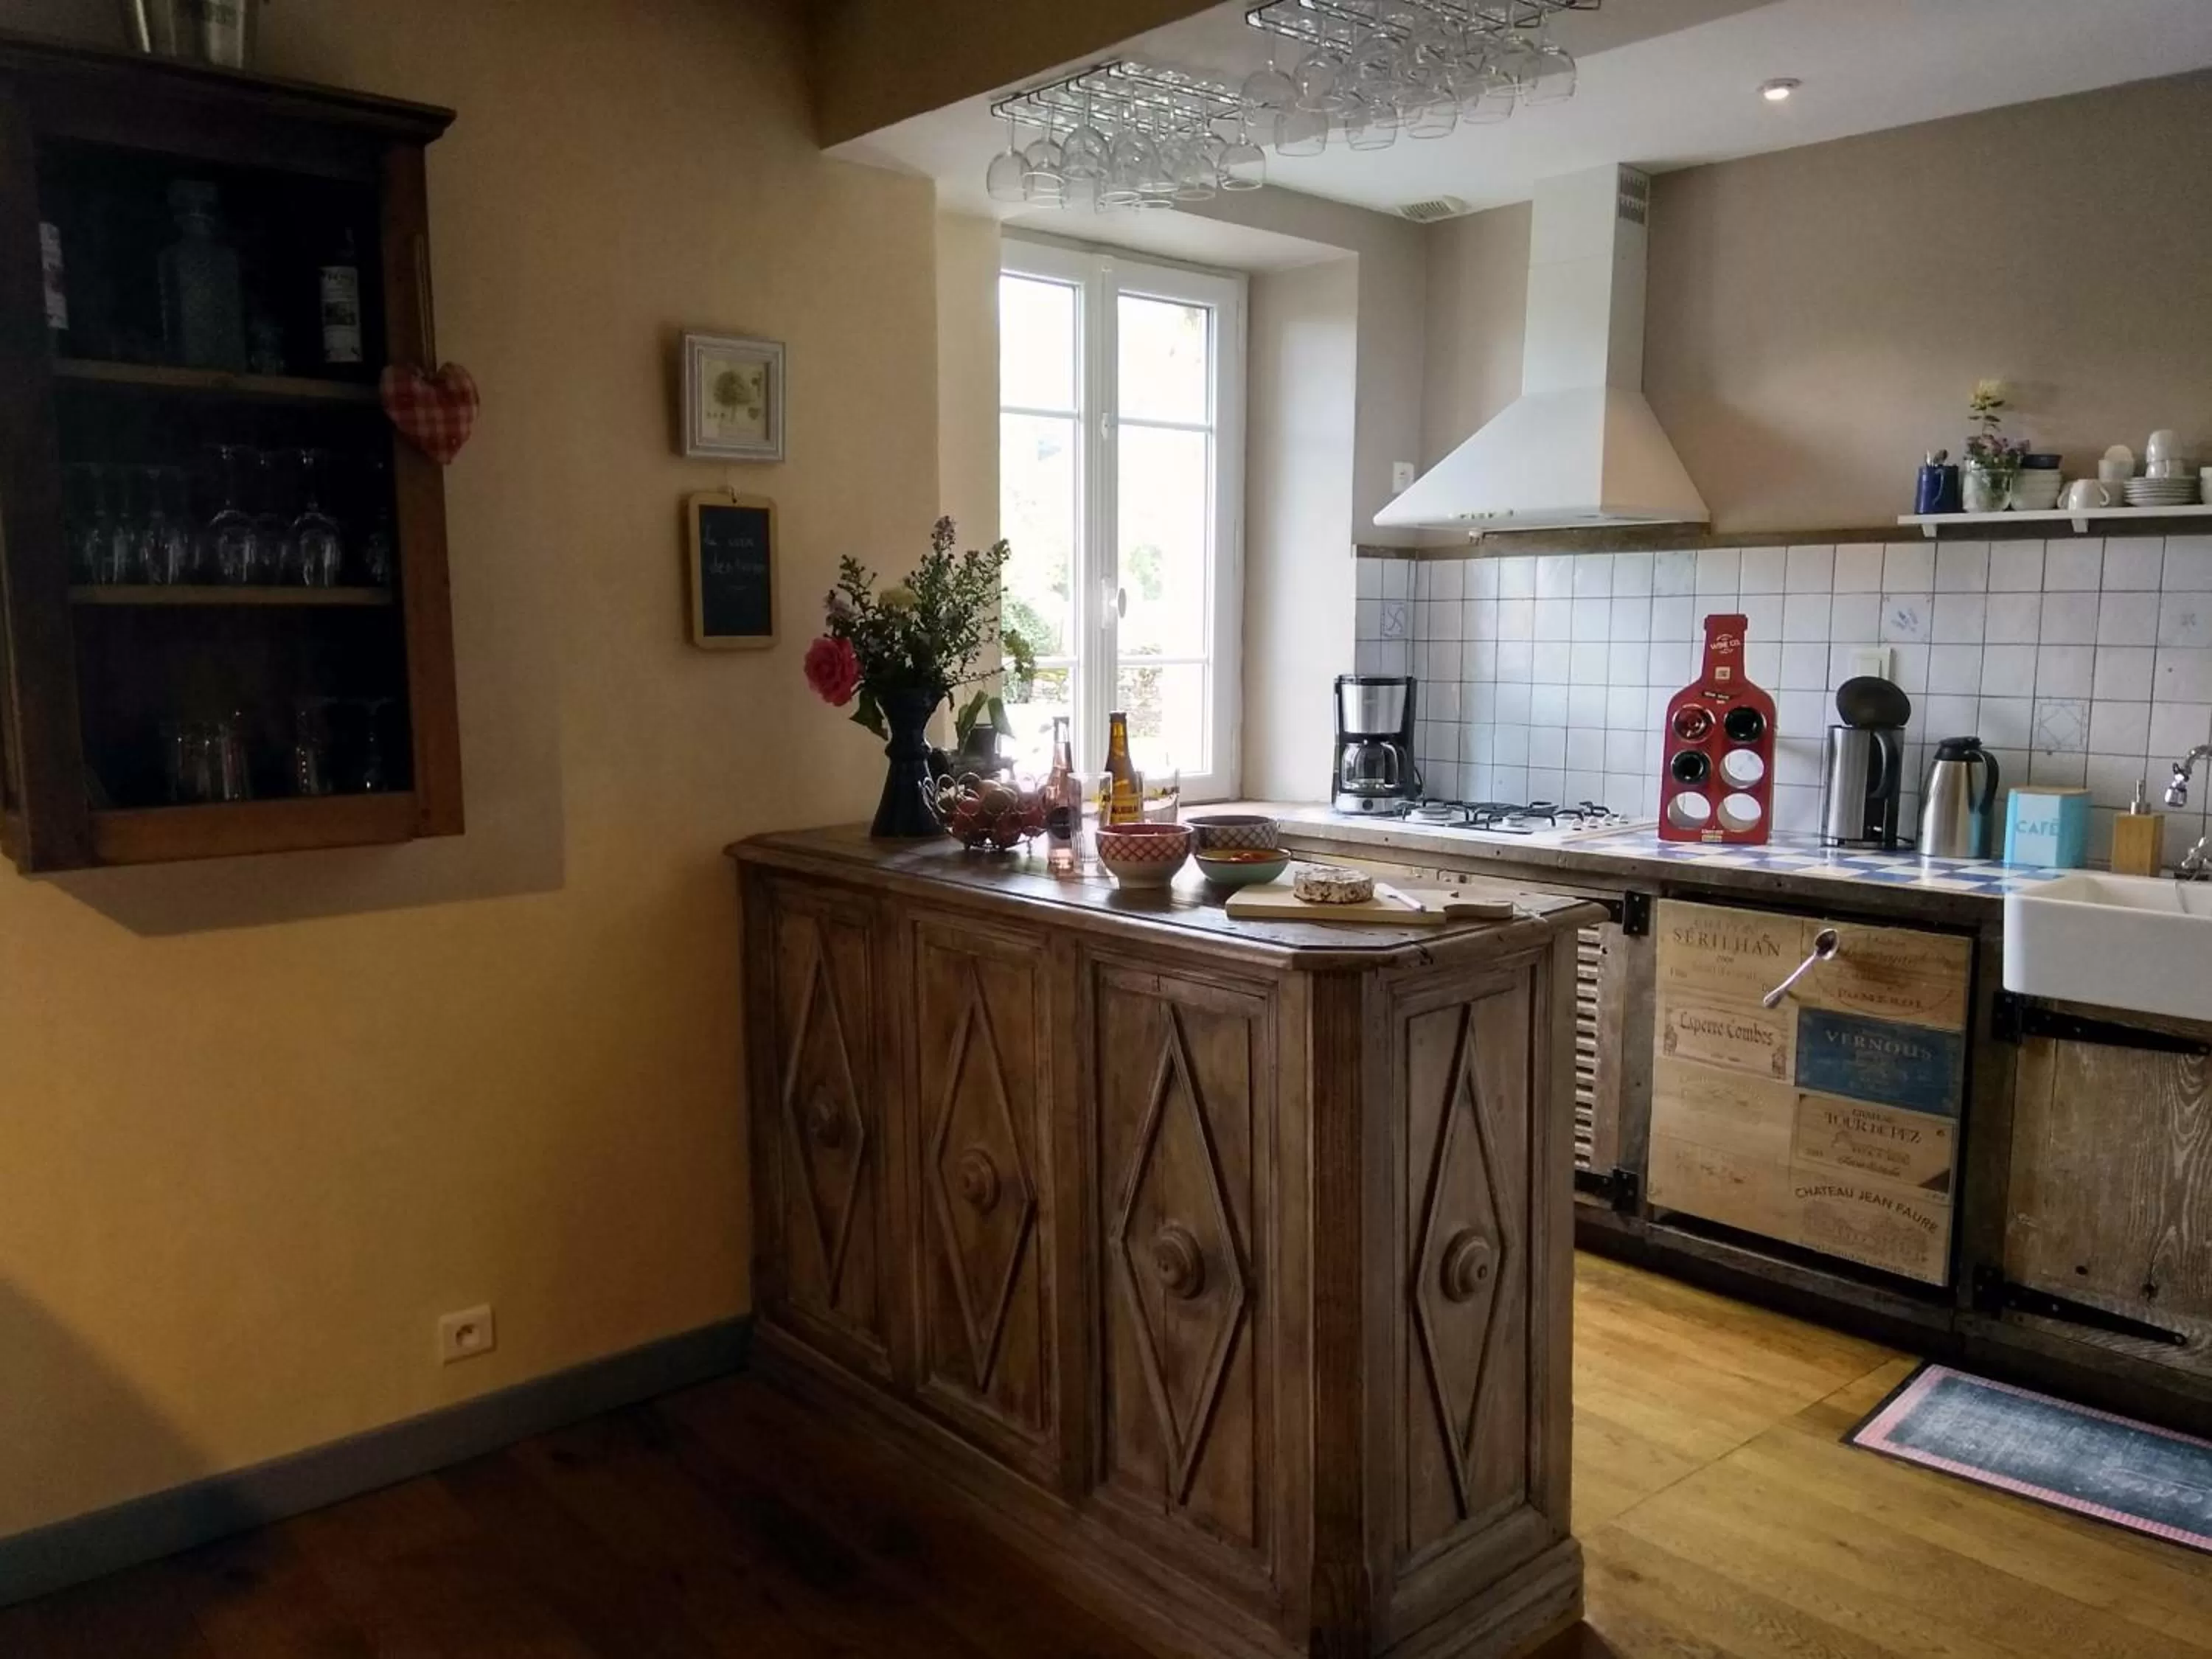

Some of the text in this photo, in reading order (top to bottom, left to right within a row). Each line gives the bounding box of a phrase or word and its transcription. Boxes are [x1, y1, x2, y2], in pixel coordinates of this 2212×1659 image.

[2016, 818, 2060, 836] CAFÉ
[1857, 1190, 1893, 1210] JEAN
[1895, 1202, 1939, 1235] FAURE
